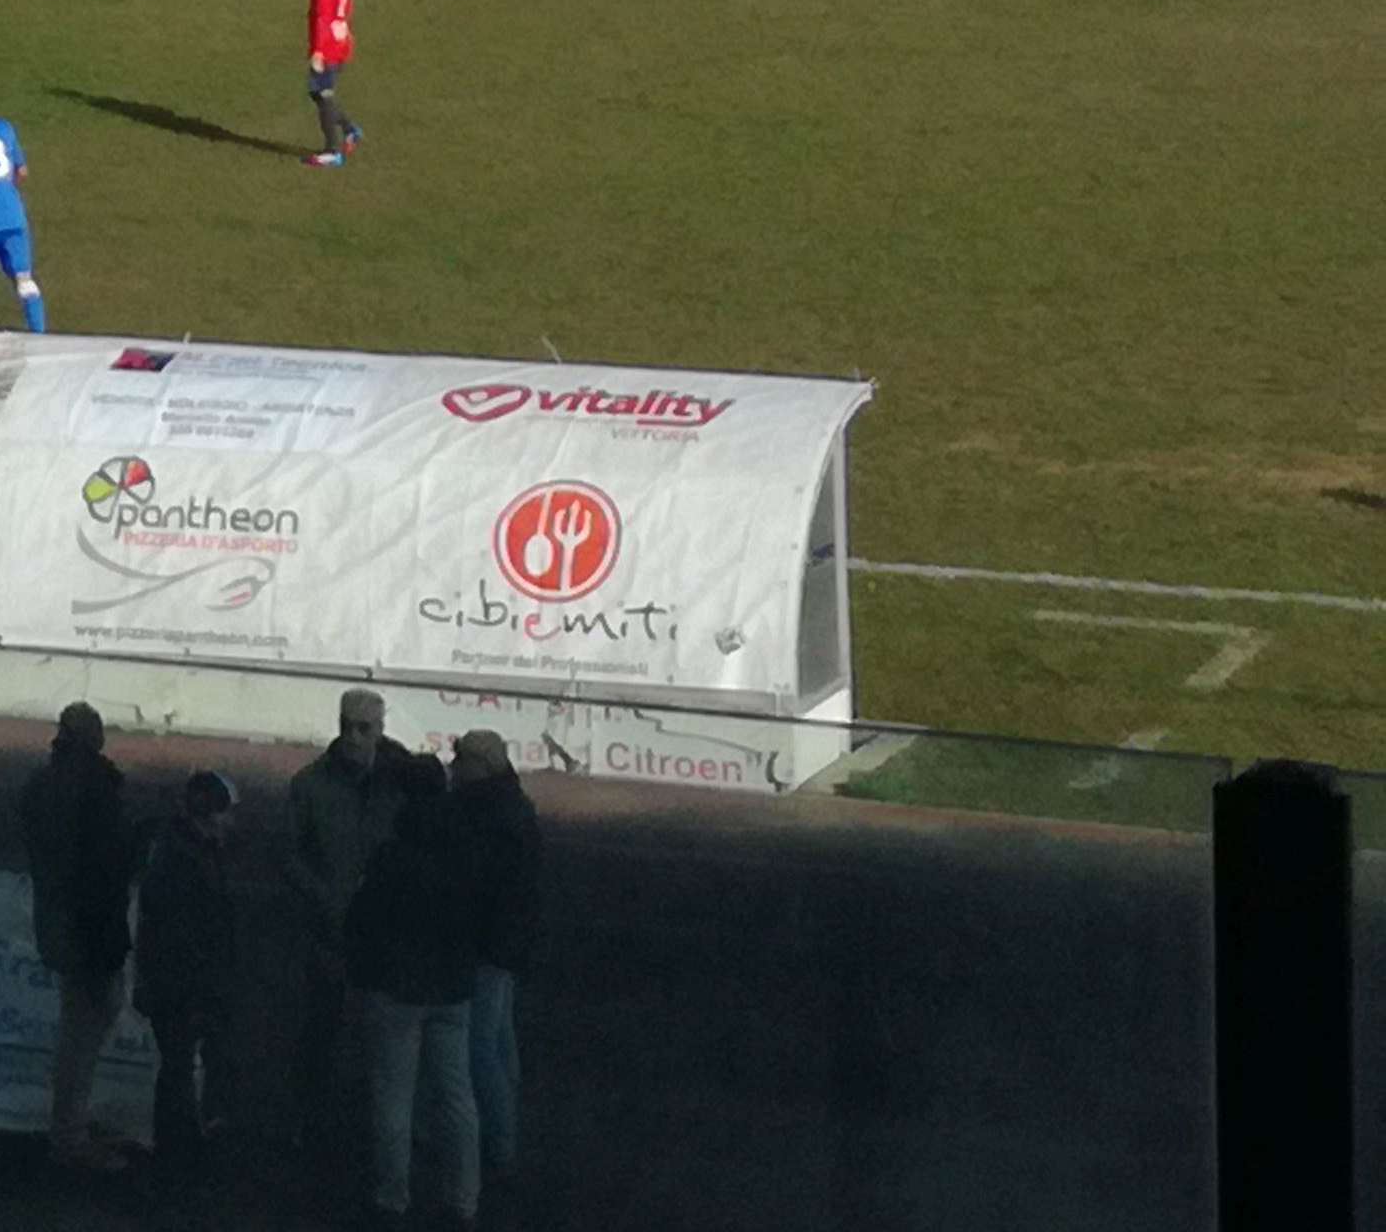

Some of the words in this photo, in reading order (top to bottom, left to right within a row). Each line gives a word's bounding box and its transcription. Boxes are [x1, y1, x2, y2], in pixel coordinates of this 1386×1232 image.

[537, 385, 737, 426] vitality
[114, 495, 300, 539] pantheon
[123, 531, 197, 548] PIZZERIA
